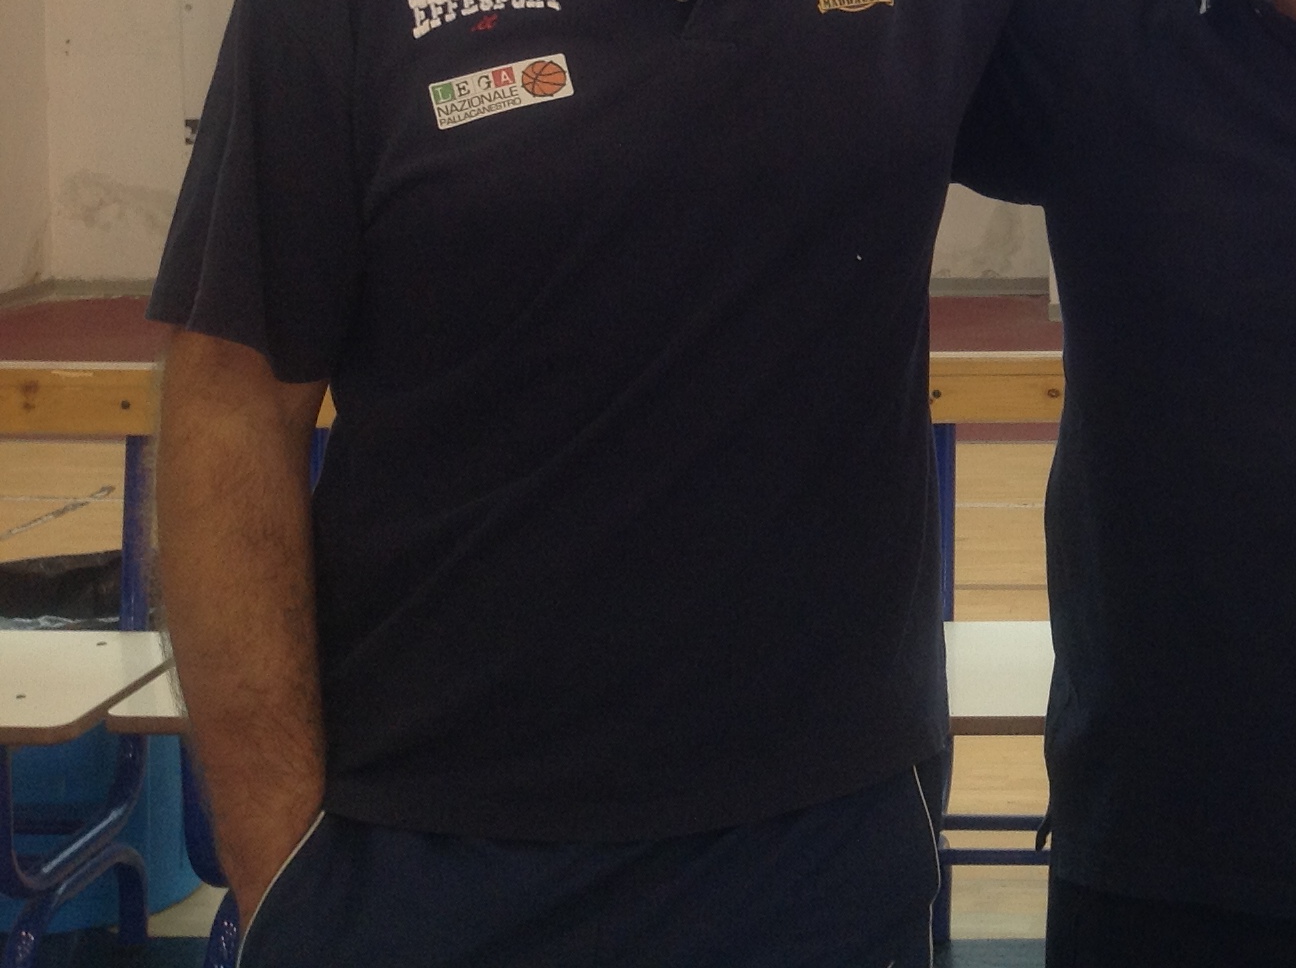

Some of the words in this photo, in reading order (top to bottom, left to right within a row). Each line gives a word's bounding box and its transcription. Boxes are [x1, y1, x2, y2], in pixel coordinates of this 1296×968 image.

[432, 70, 514, 103] LEGA
[437, 85, 520, 117] NAZIONALE
[440, 97, 522, 127] PALLACANESTRO
